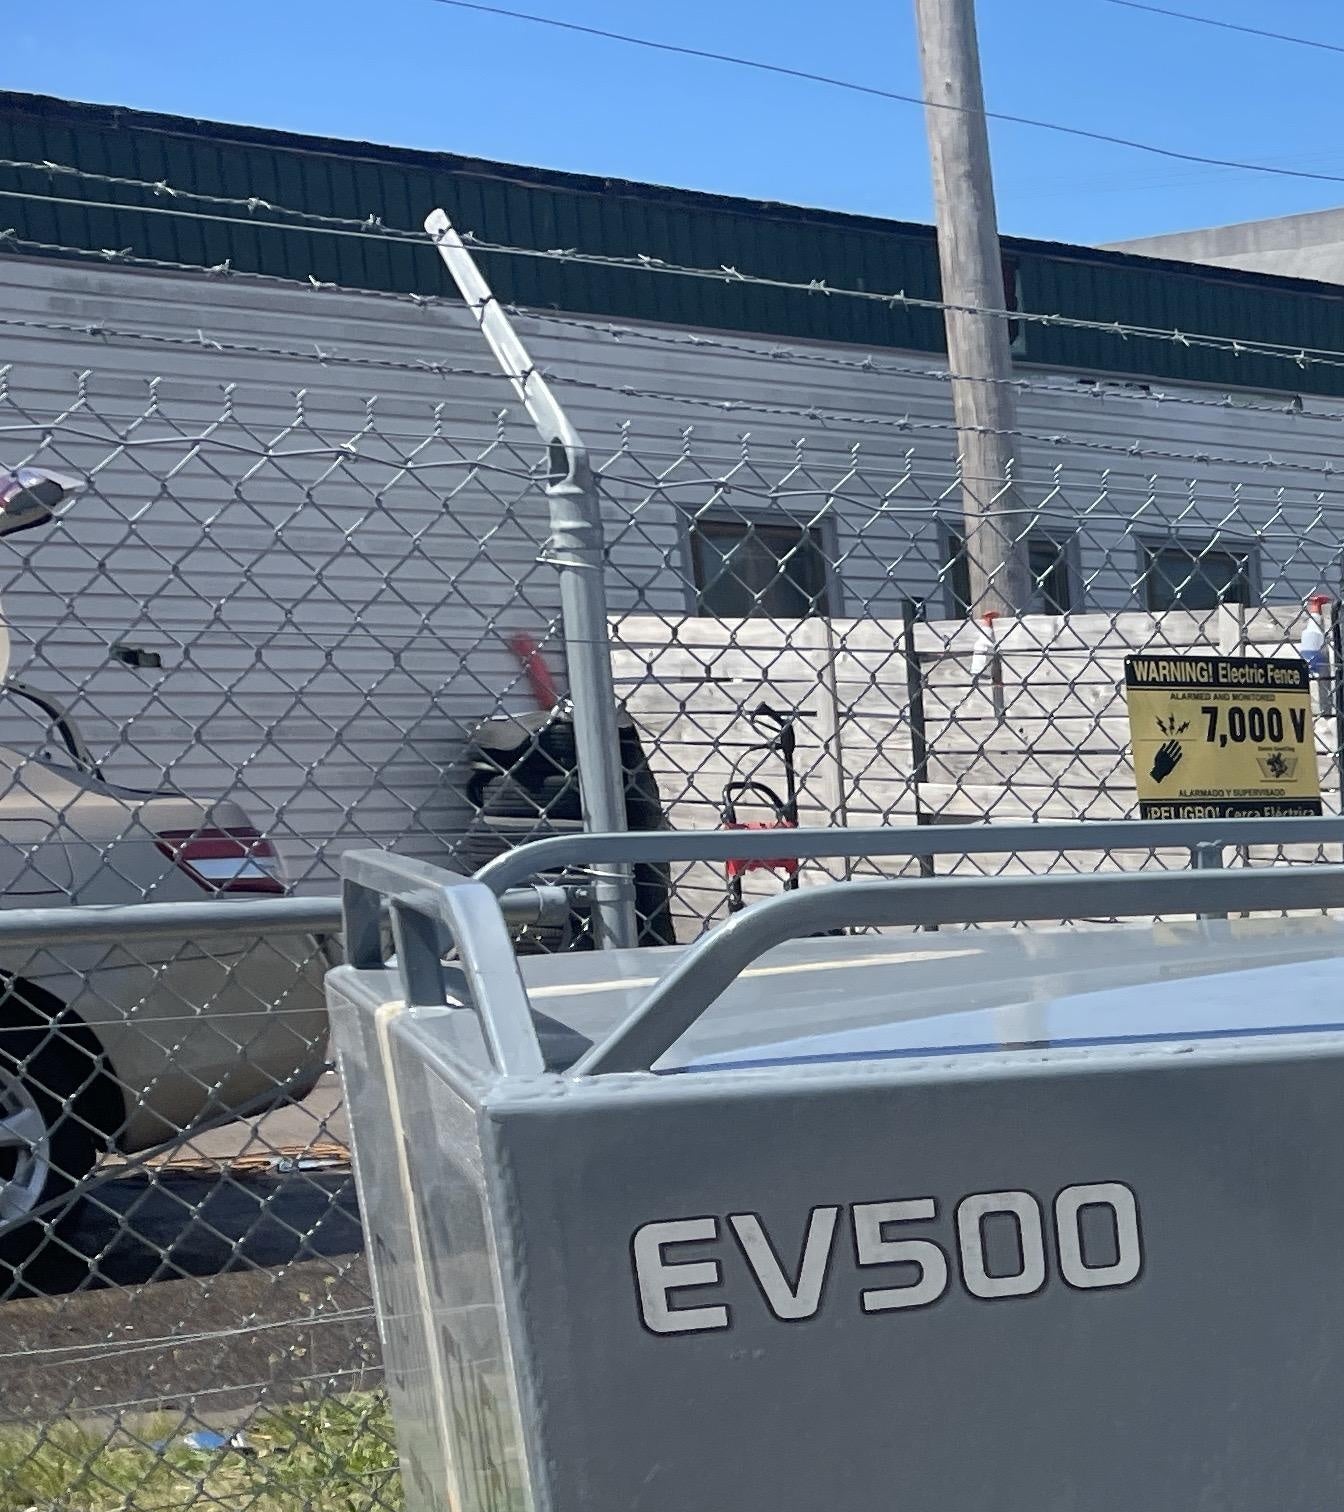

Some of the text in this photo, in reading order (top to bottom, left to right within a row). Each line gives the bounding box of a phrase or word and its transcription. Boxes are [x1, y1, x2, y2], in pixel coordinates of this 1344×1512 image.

[1133, 660, 1300, 685] WARNING! Electric Fence
[1169, 693, 1276, 702] ALARMED AND MONITORED
[1201, 706, 1306, 748] 7,000 V
[1178, 788, 1225, 798] ALARMADO
[1233, 788, 1286, 797] SUPERVISADO
[629, 1180, 1144, 1337] EV500
